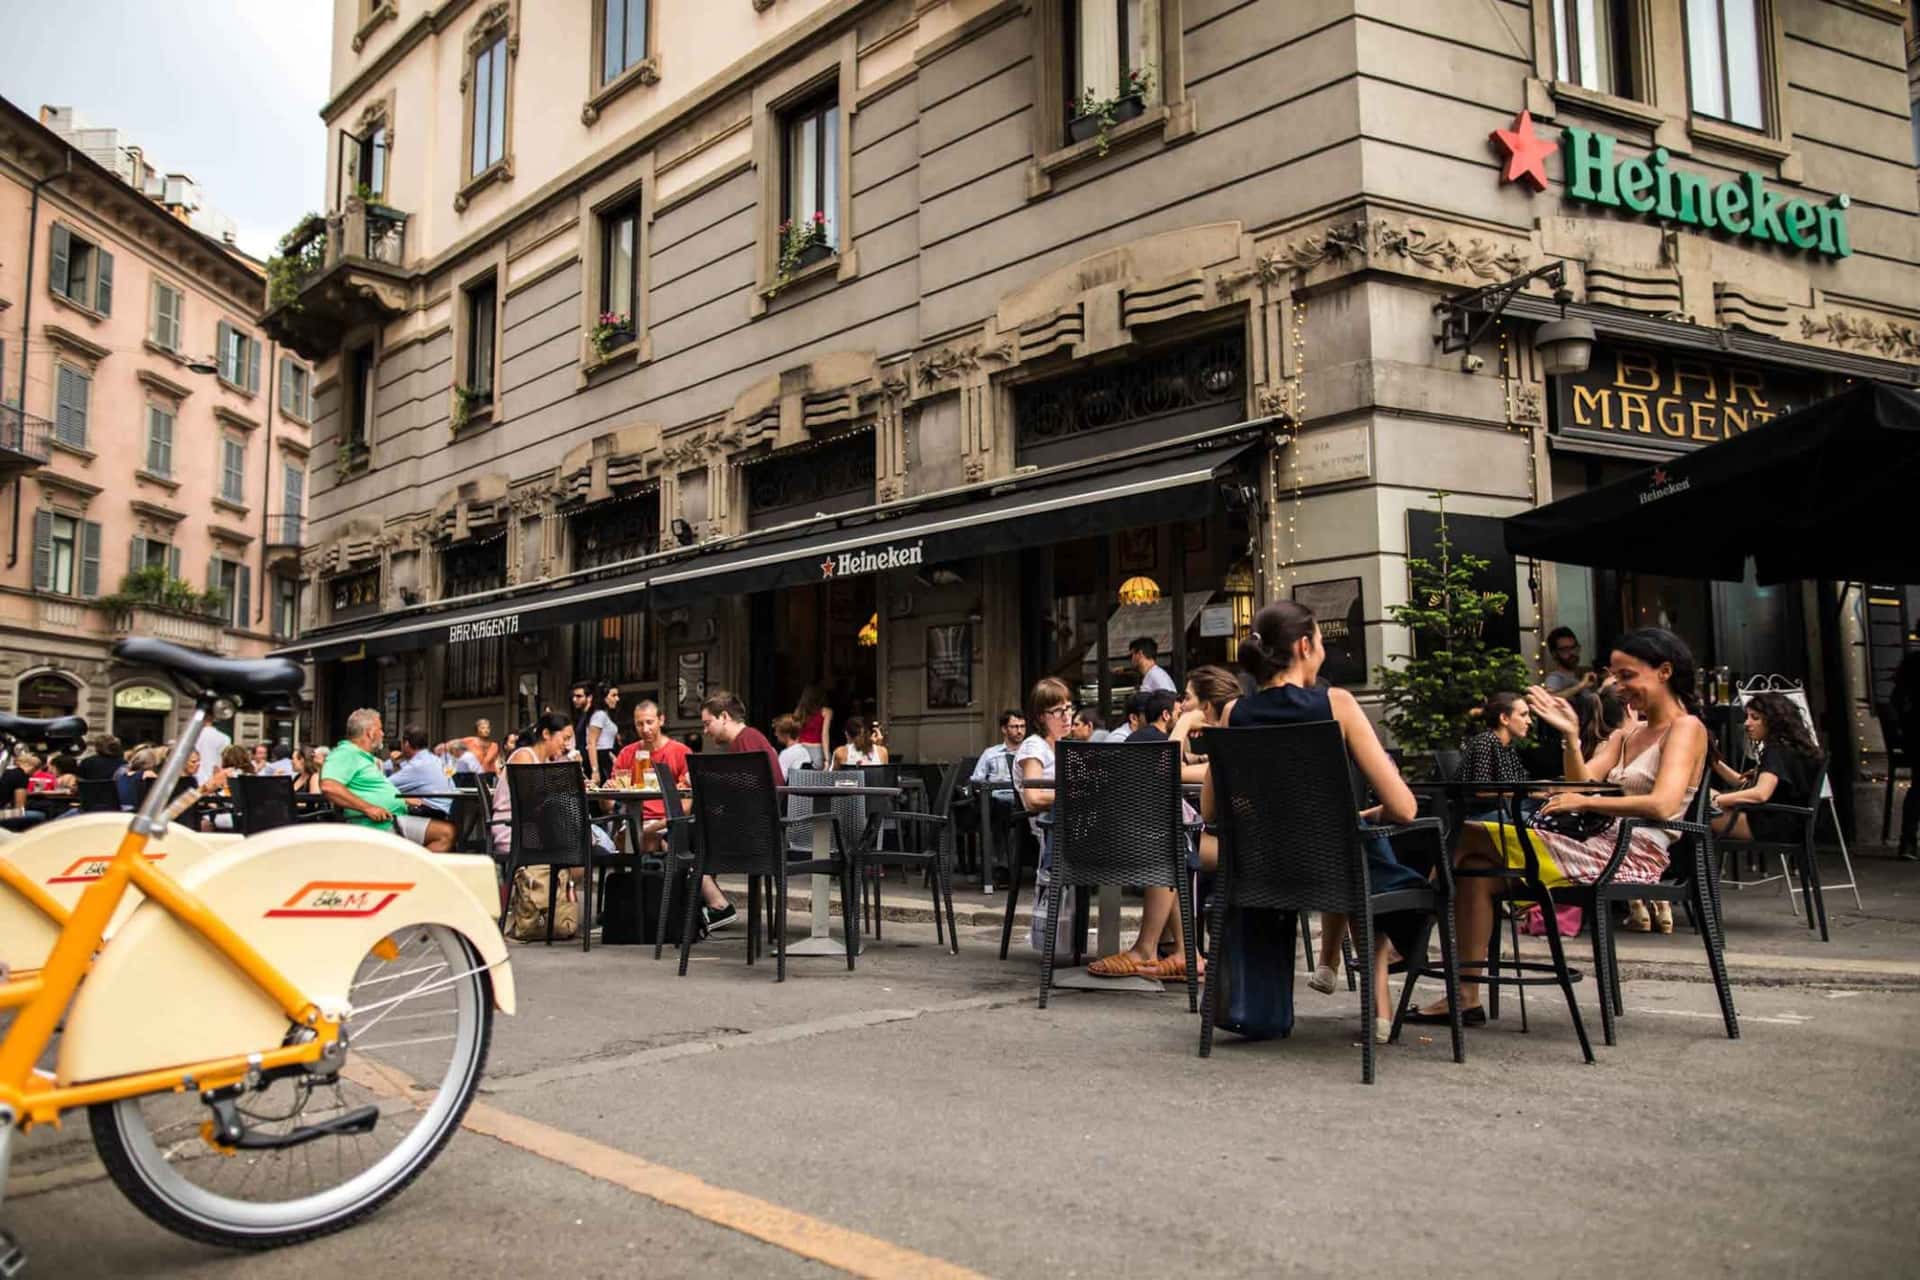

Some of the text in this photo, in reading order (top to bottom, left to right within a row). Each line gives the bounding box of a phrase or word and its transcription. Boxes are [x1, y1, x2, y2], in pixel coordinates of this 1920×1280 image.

[1562, 126, 1854, 259] Heineken
[1612, 351, 1769, 408] BAR
[1572, 384, 1777, 442] MAGENT
[1639, 476, 1690, 505] Heineken
[836, 540, 924, 576] Heineken
